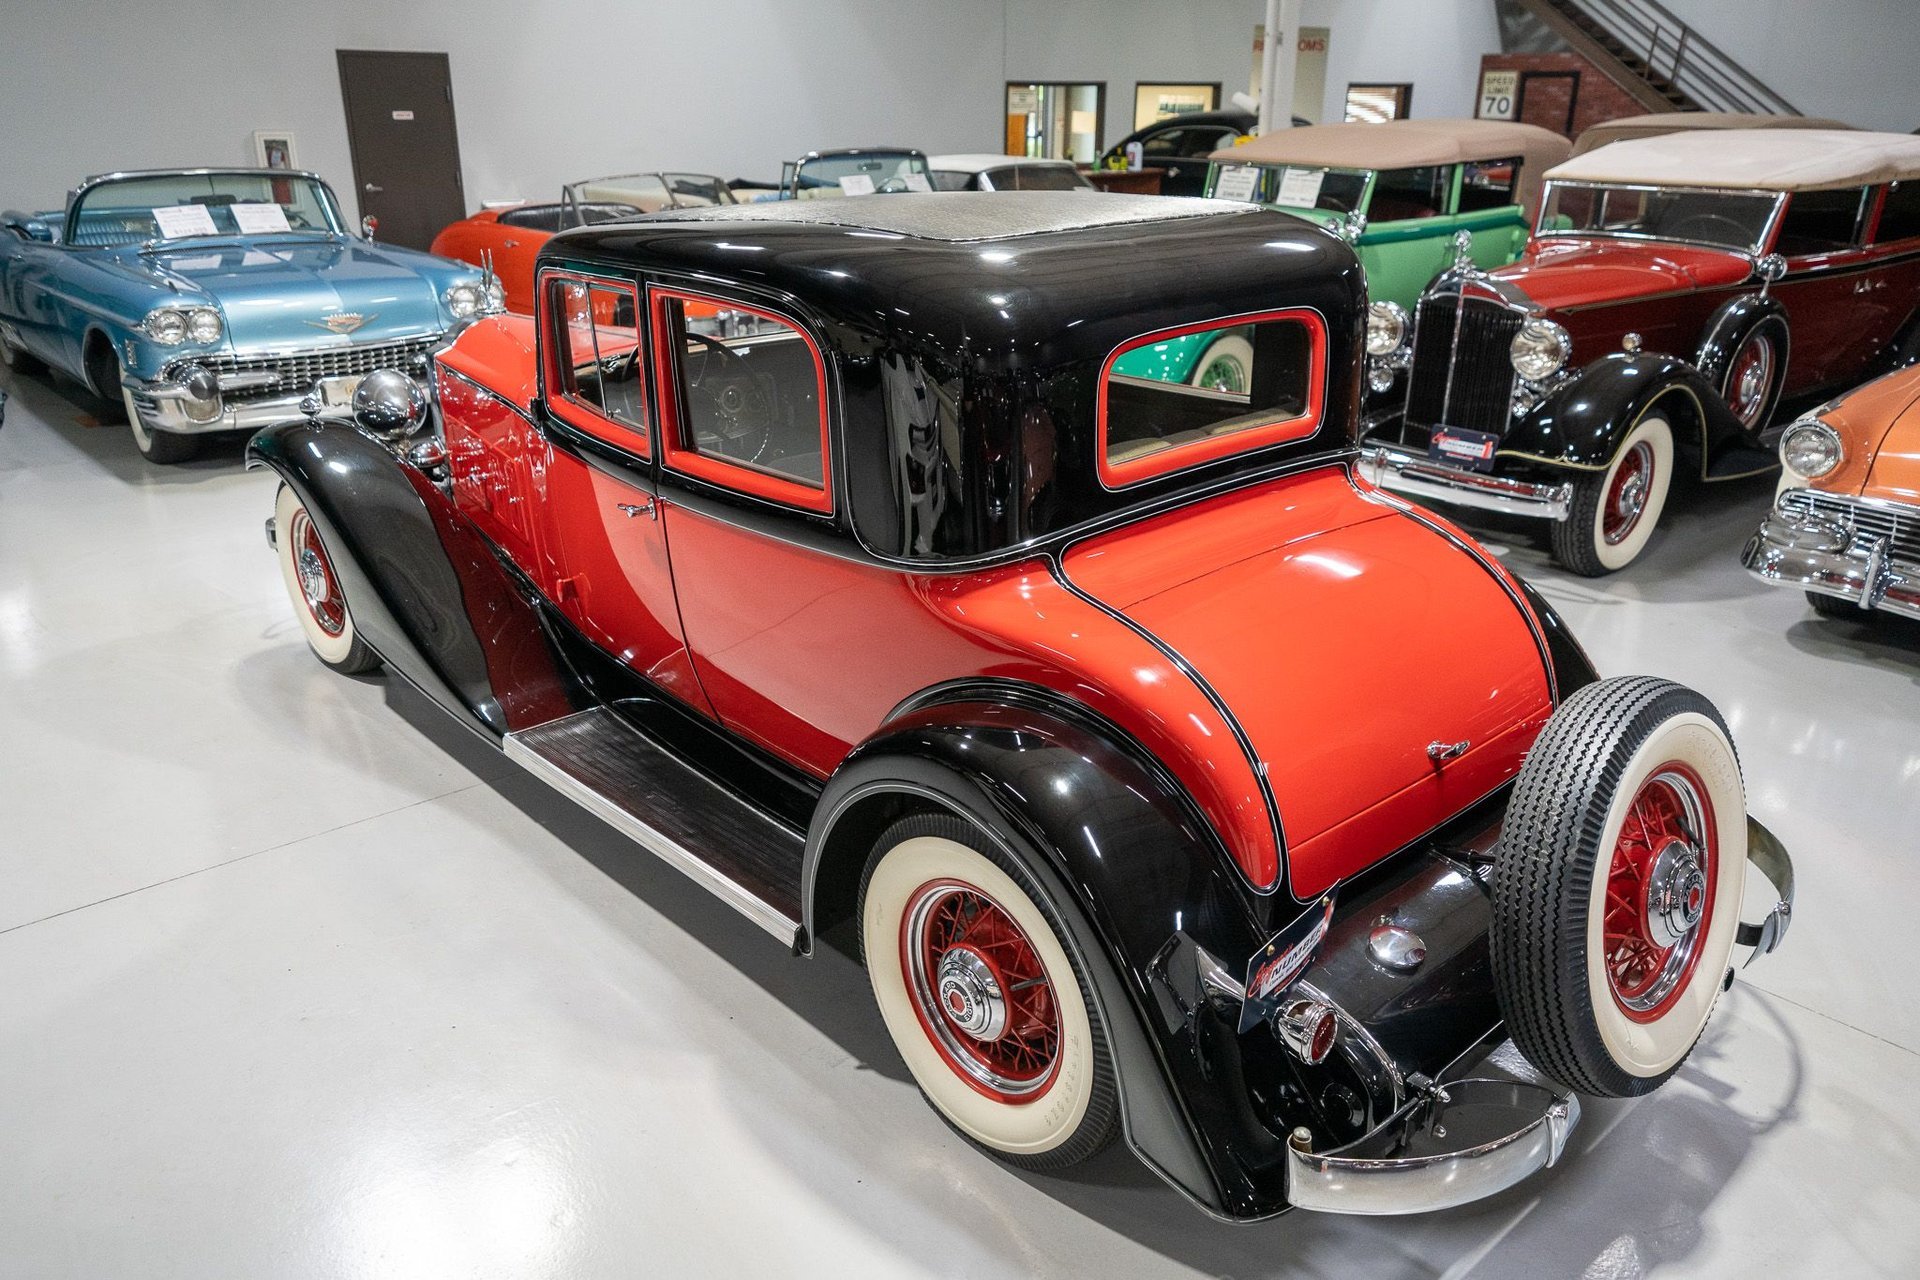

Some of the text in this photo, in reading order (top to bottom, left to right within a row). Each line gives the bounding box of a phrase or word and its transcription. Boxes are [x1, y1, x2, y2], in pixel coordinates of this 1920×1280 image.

[1486, 76, 1514, 85] SPEED
[1485, 96, 1510, 114] 70
[1271, 927, 1322, 979] NUMBER
